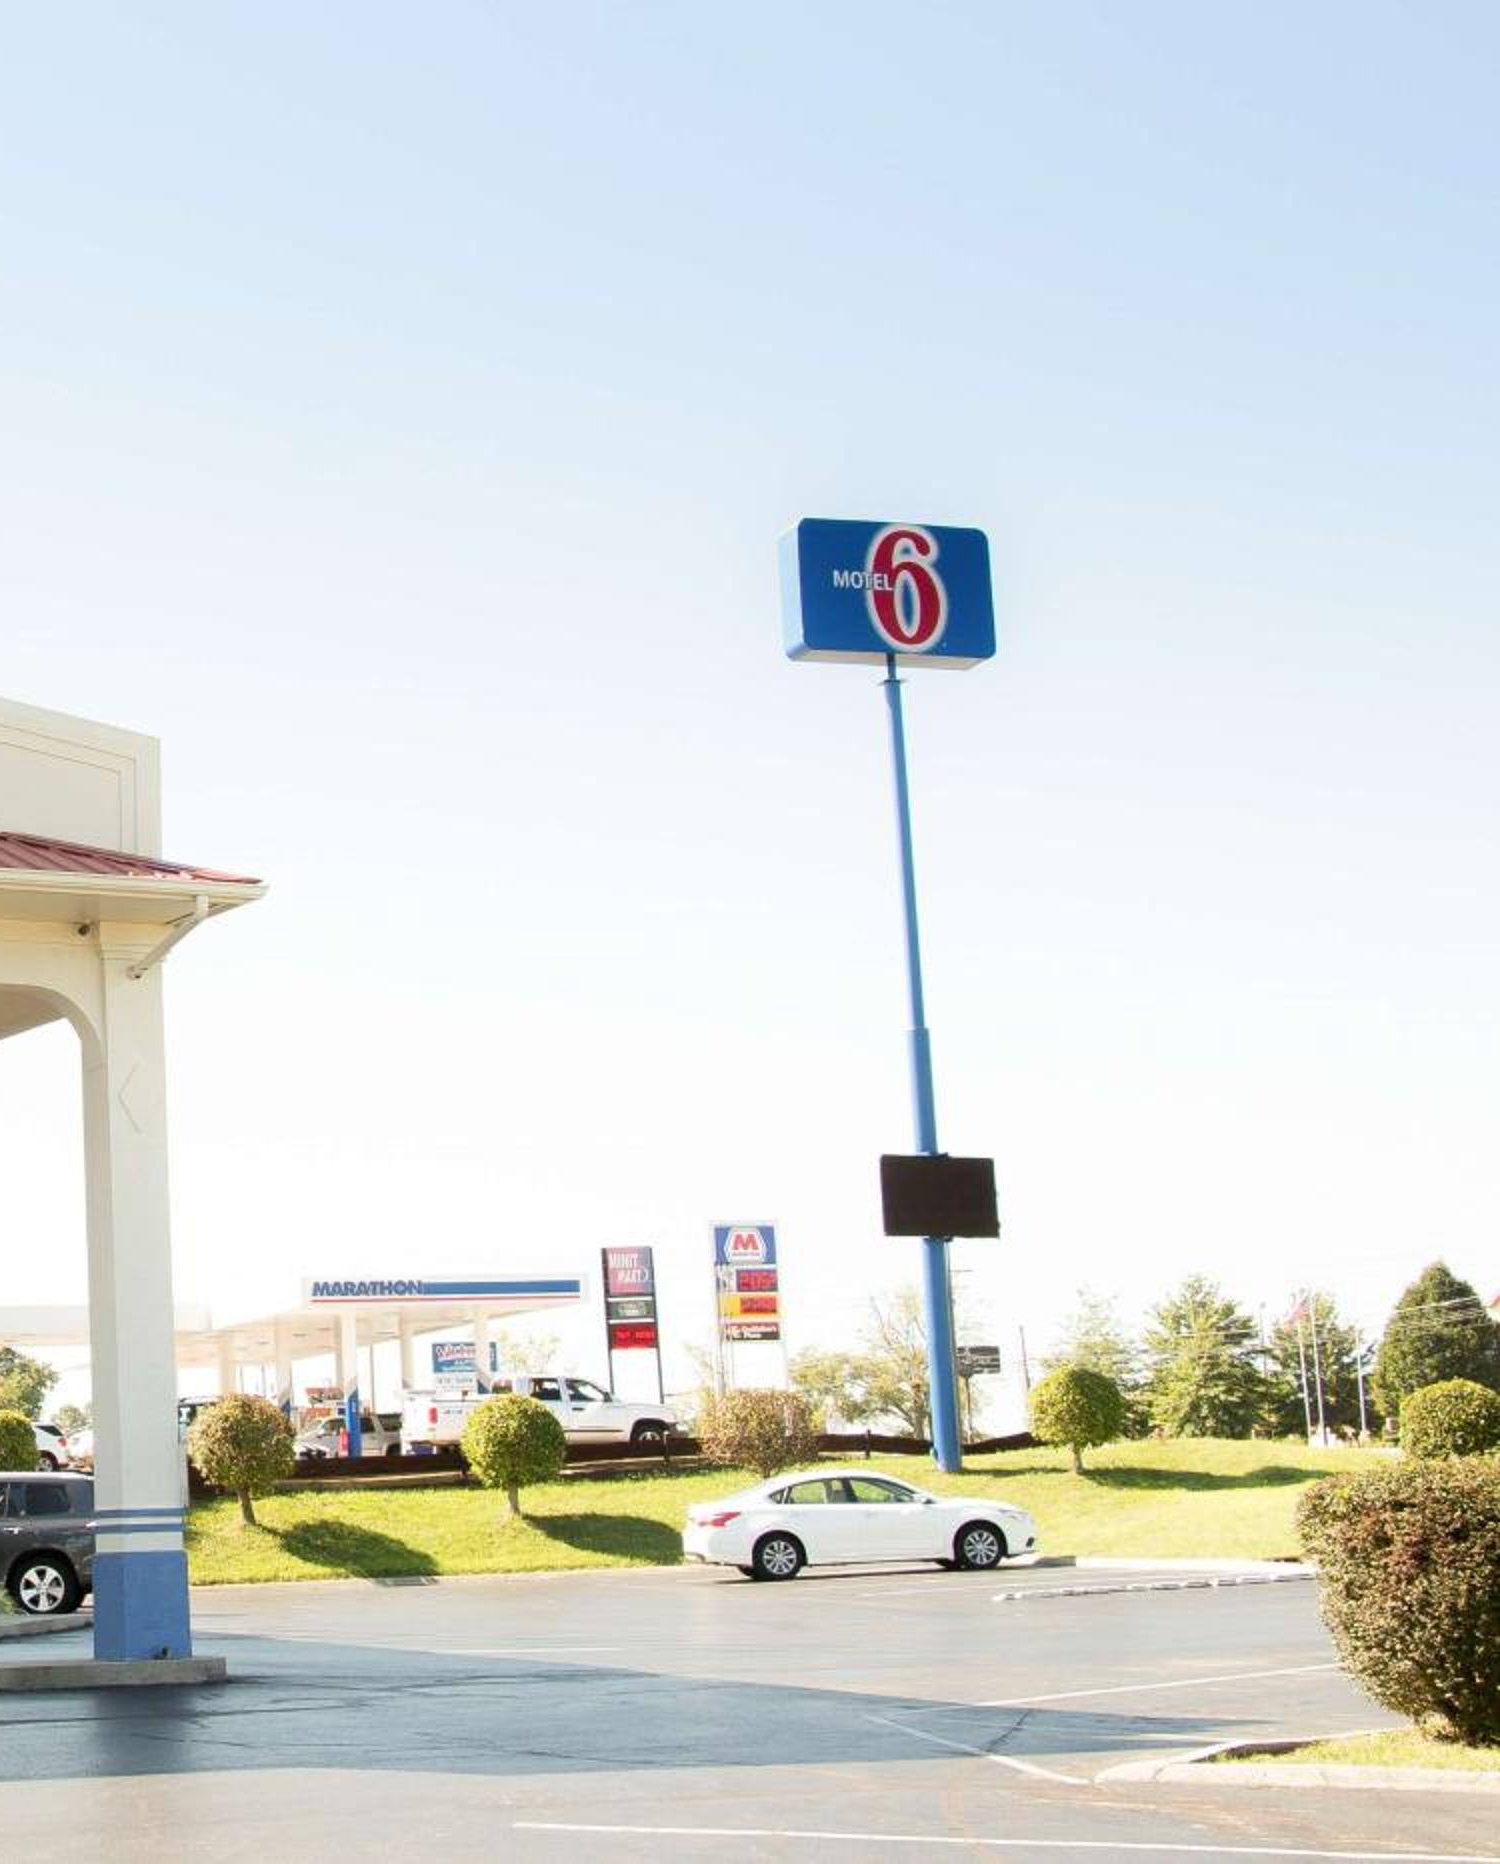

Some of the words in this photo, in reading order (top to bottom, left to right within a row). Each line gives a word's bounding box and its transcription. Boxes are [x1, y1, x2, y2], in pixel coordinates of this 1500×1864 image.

[833, 569, 893, 591] MOTEL
[869, 527, 944, 648] 6
[312, 1280, 422, 1297] MARATHON
